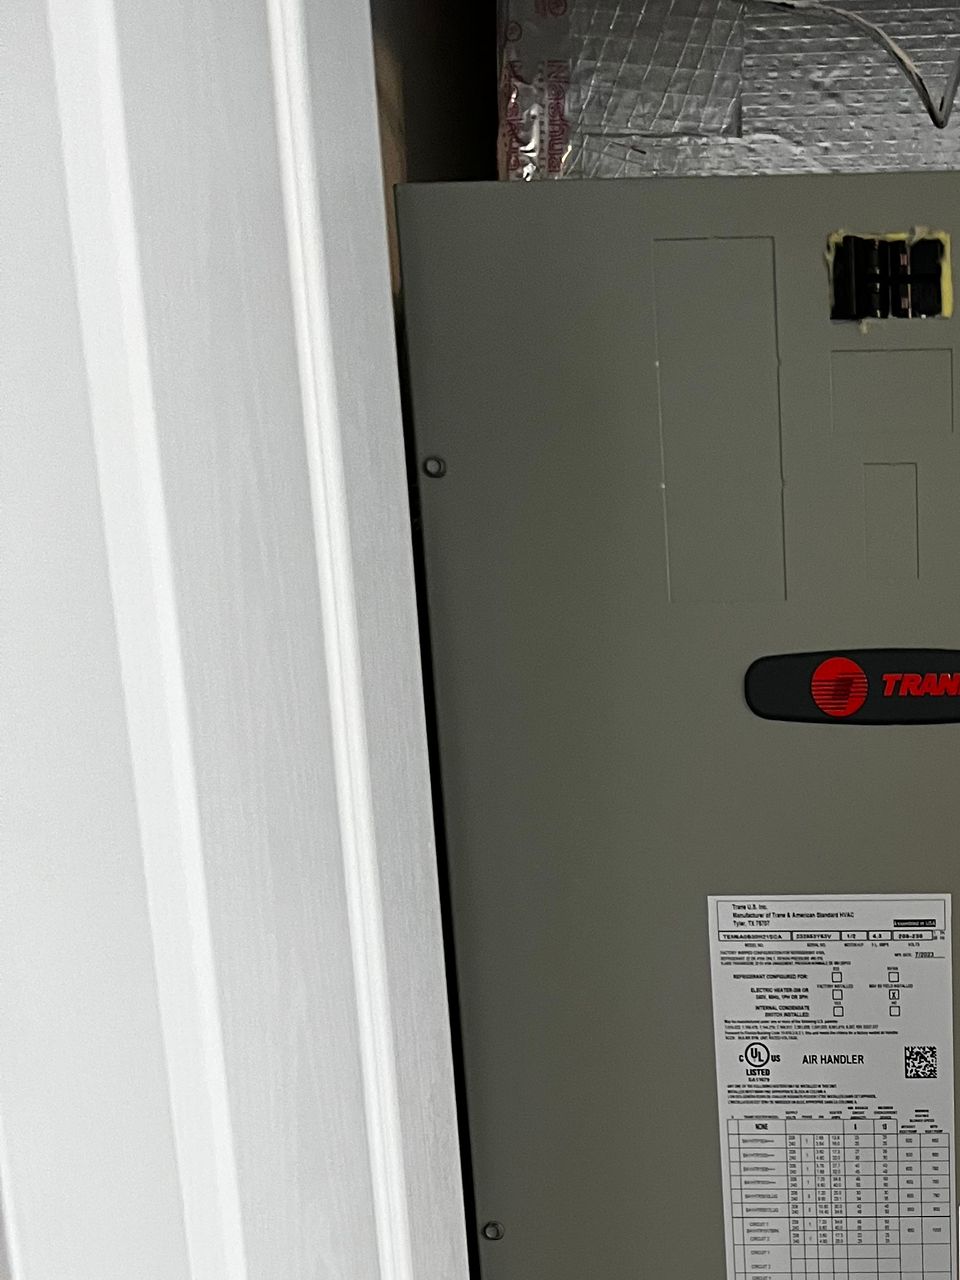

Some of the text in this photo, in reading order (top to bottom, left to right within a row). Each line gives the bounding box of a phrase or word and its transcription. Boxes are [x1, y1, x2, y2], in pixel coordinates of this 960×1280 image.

[803, 1055, 864, 1064] AIR HANDLER
[746, 1069, 770, 1077] LISTED
